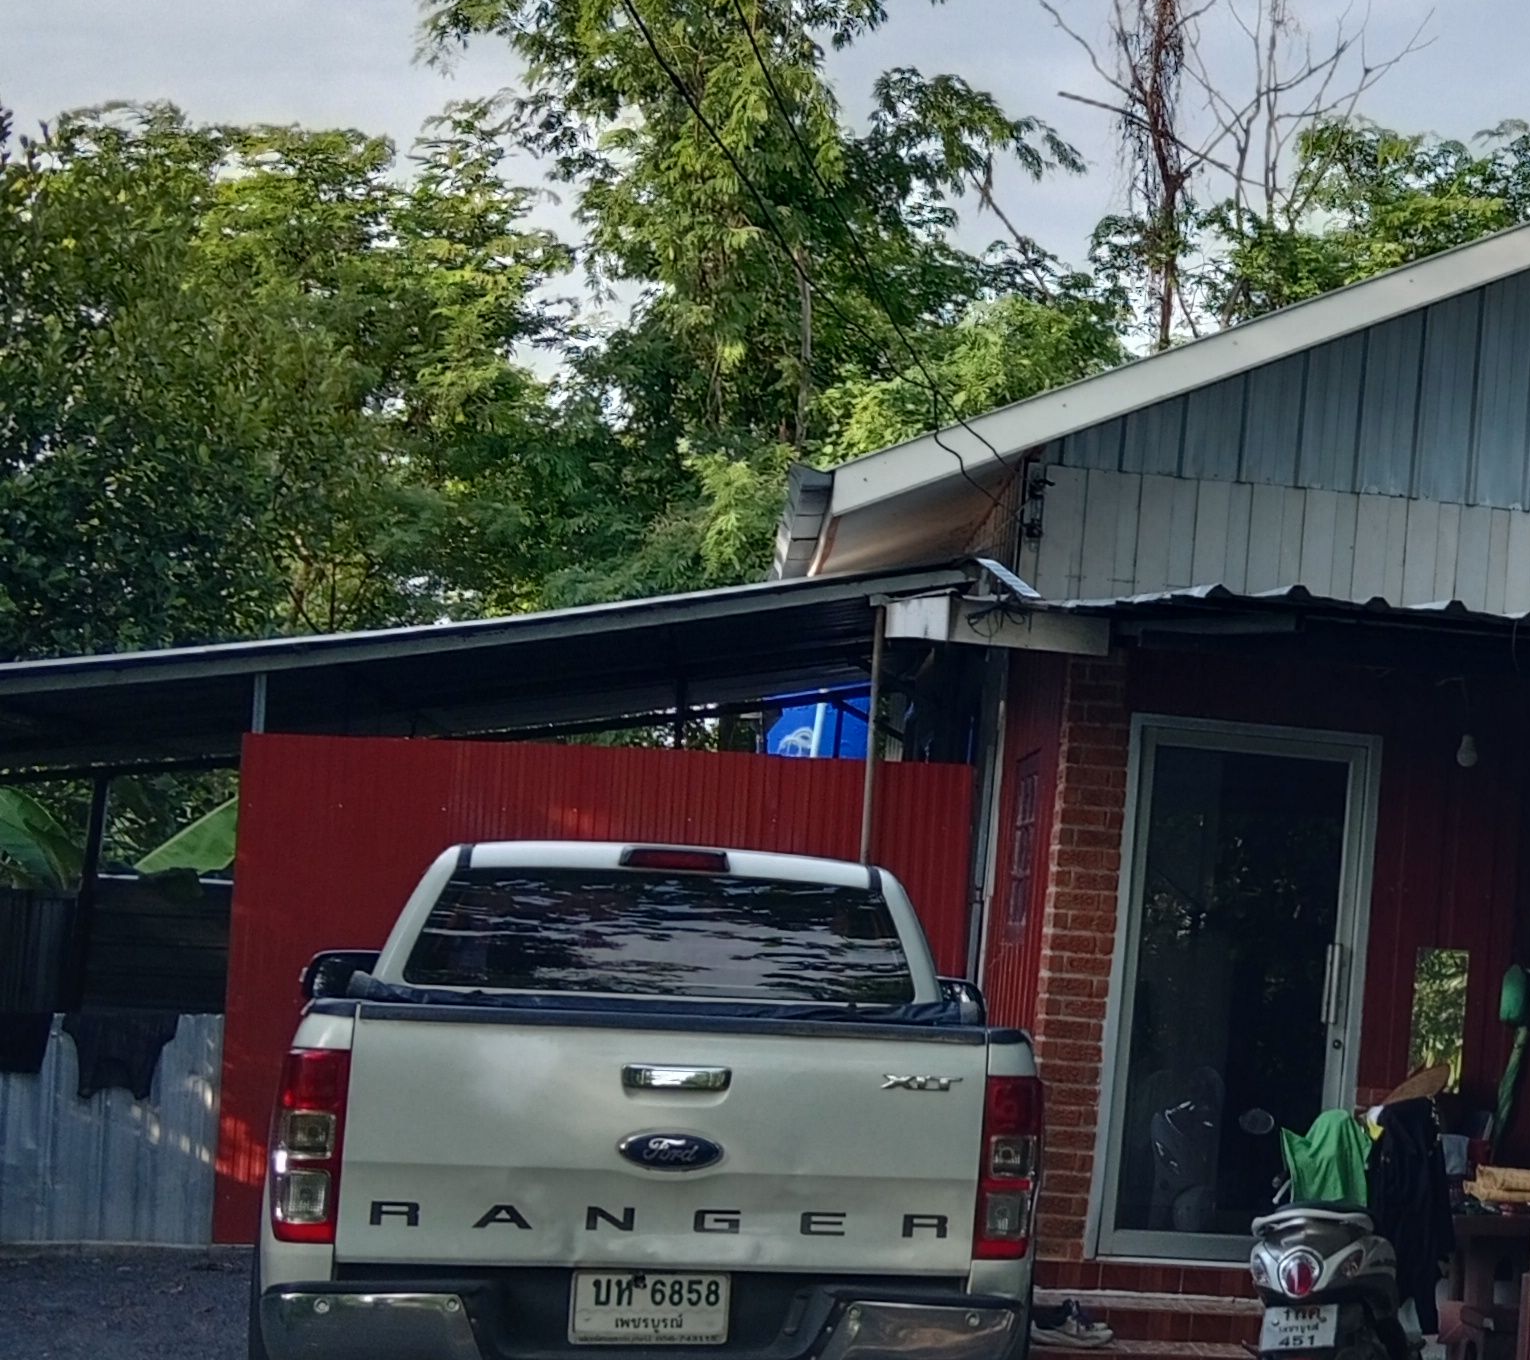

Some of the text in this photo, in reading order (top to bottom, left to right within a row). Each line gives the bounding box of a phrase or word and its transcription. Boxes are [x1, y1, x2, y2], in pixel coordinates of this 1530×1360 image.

[643, 1138, 699, 1162] Ford
[369, 1200, 948, 1239] RANGER
[651, 1279, 720, 1307] 6858
[614, 1313, 684, 1334] เพชรบูรณ์
[1278, 1335, 1315, 1346] 451
